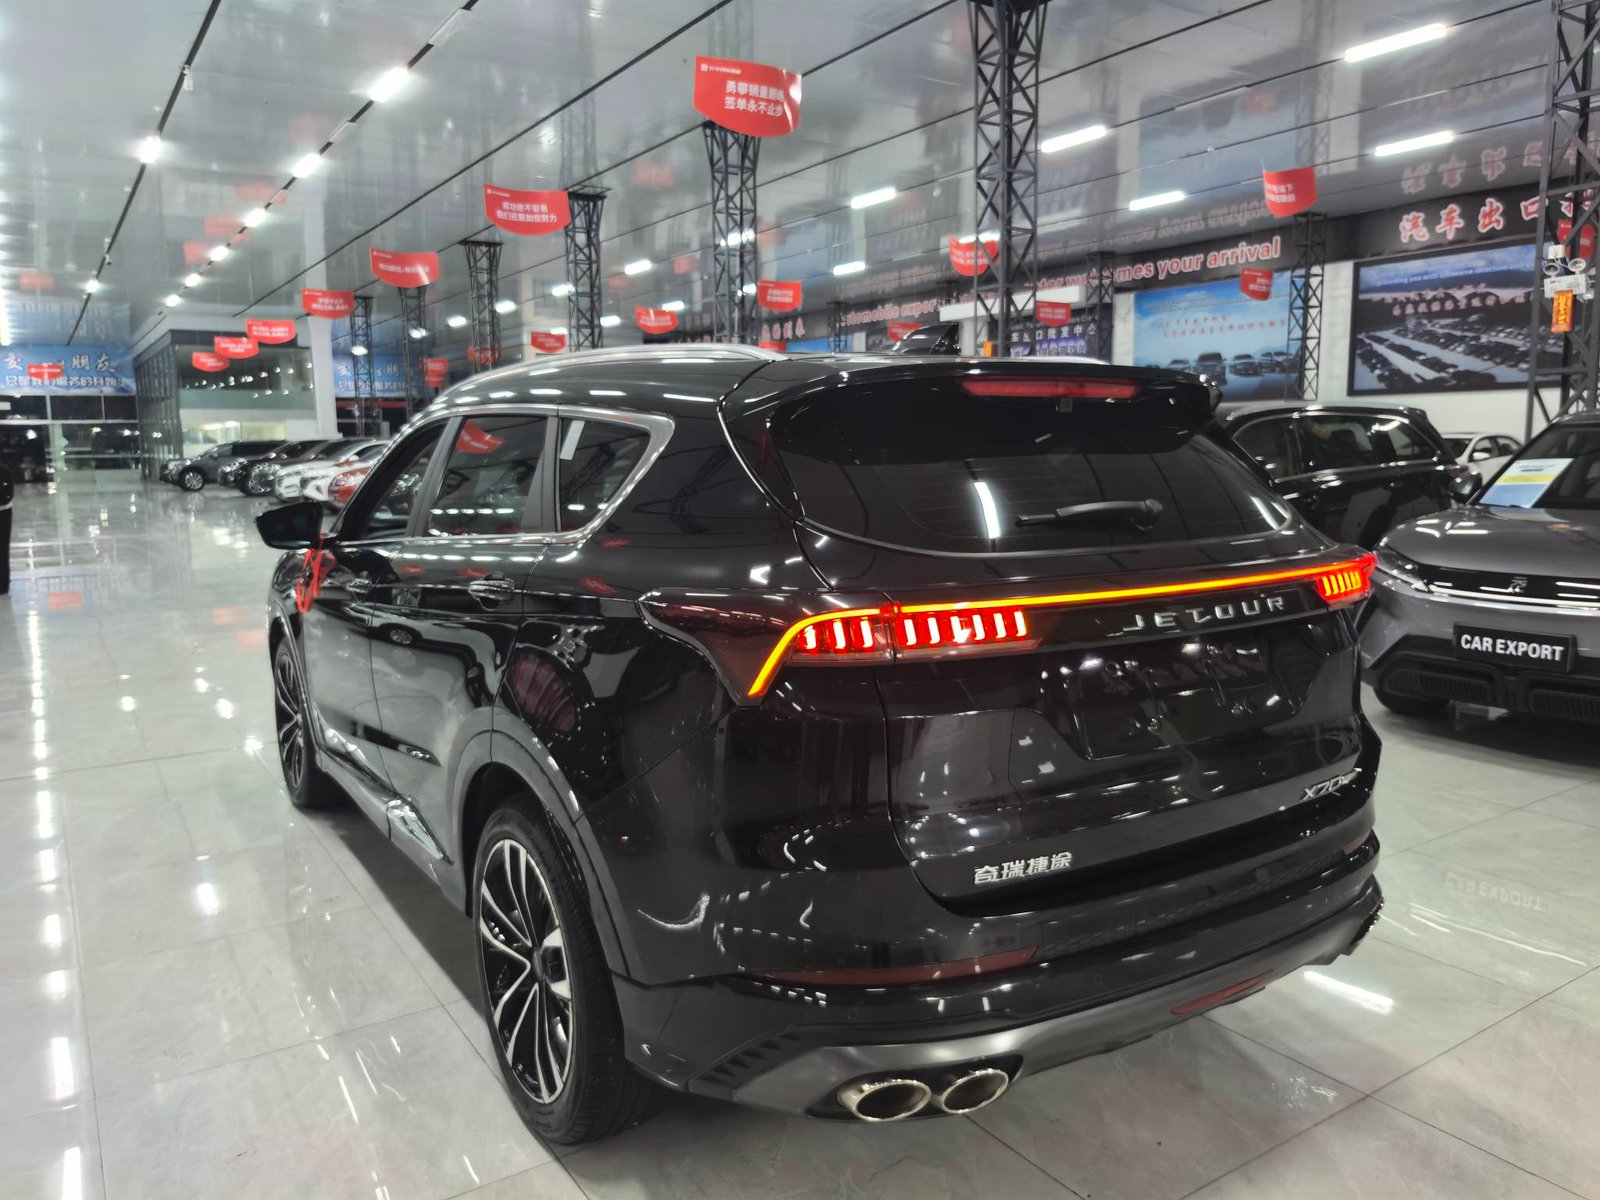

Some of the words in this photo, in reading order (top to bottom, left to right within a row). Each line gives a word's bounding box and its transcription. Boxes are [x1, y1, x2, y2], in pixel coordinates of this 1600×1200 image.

[1157, 253, 1204, 280] your
[1207, 235, 1281, 267] arrival
[1123, 596, 1285, 631] JETOUR
[1460, 633, 1492, 653] CAR
[1495, 637, 1564, 662] EXPORT
[974, 851, 1072, 884] 奇瑞捷途
